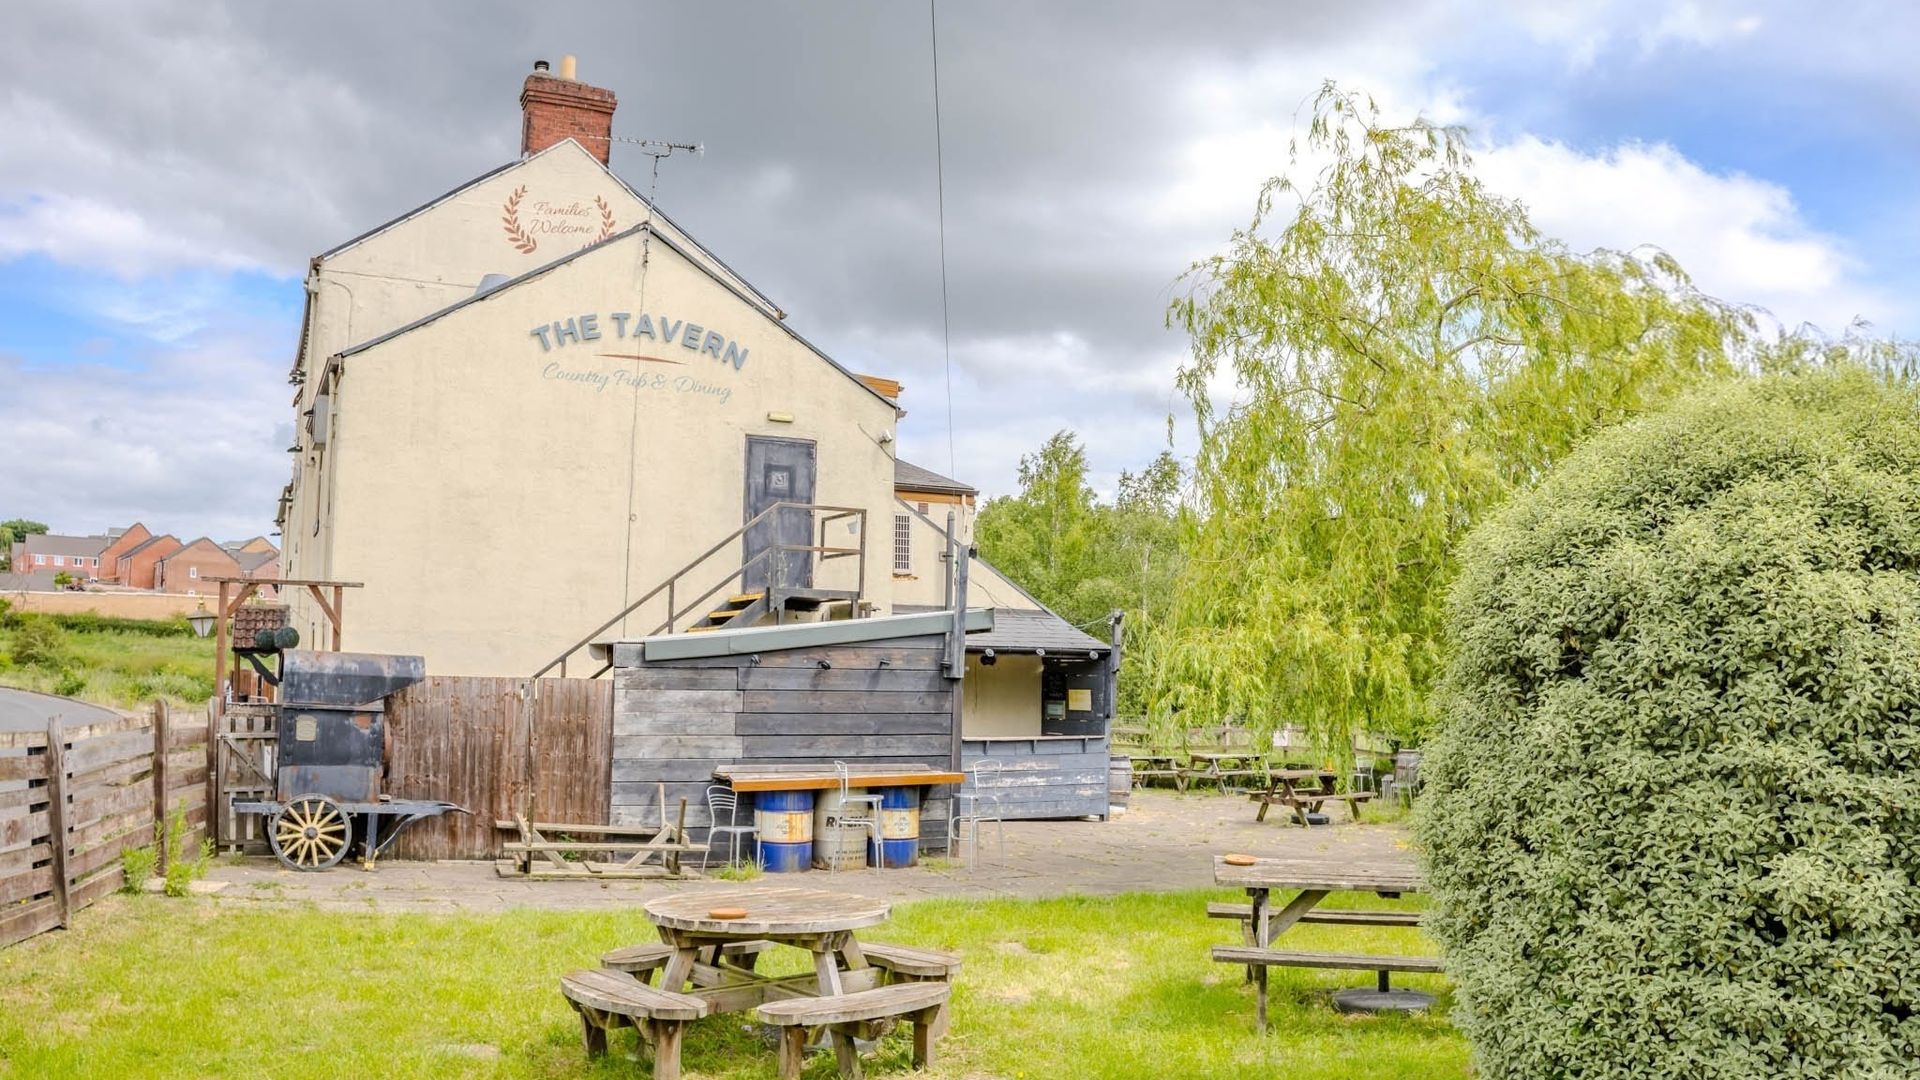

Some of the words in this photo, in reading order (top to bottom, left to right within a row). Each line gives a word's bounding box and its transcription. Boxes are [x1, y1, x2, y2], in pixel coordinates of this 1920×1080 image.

[533, 202, 592, 216] Families
[530, 219, 593, 234] Welcome
[530, 314, 602, 352] THE
[611, 312, 749, 370] TAVERN
[543, 361, 609, 392] Country
[613, 369, 647, 387] Pub
[650, 373, 666, 390] &
[674, 375, 732, 404] Dining
